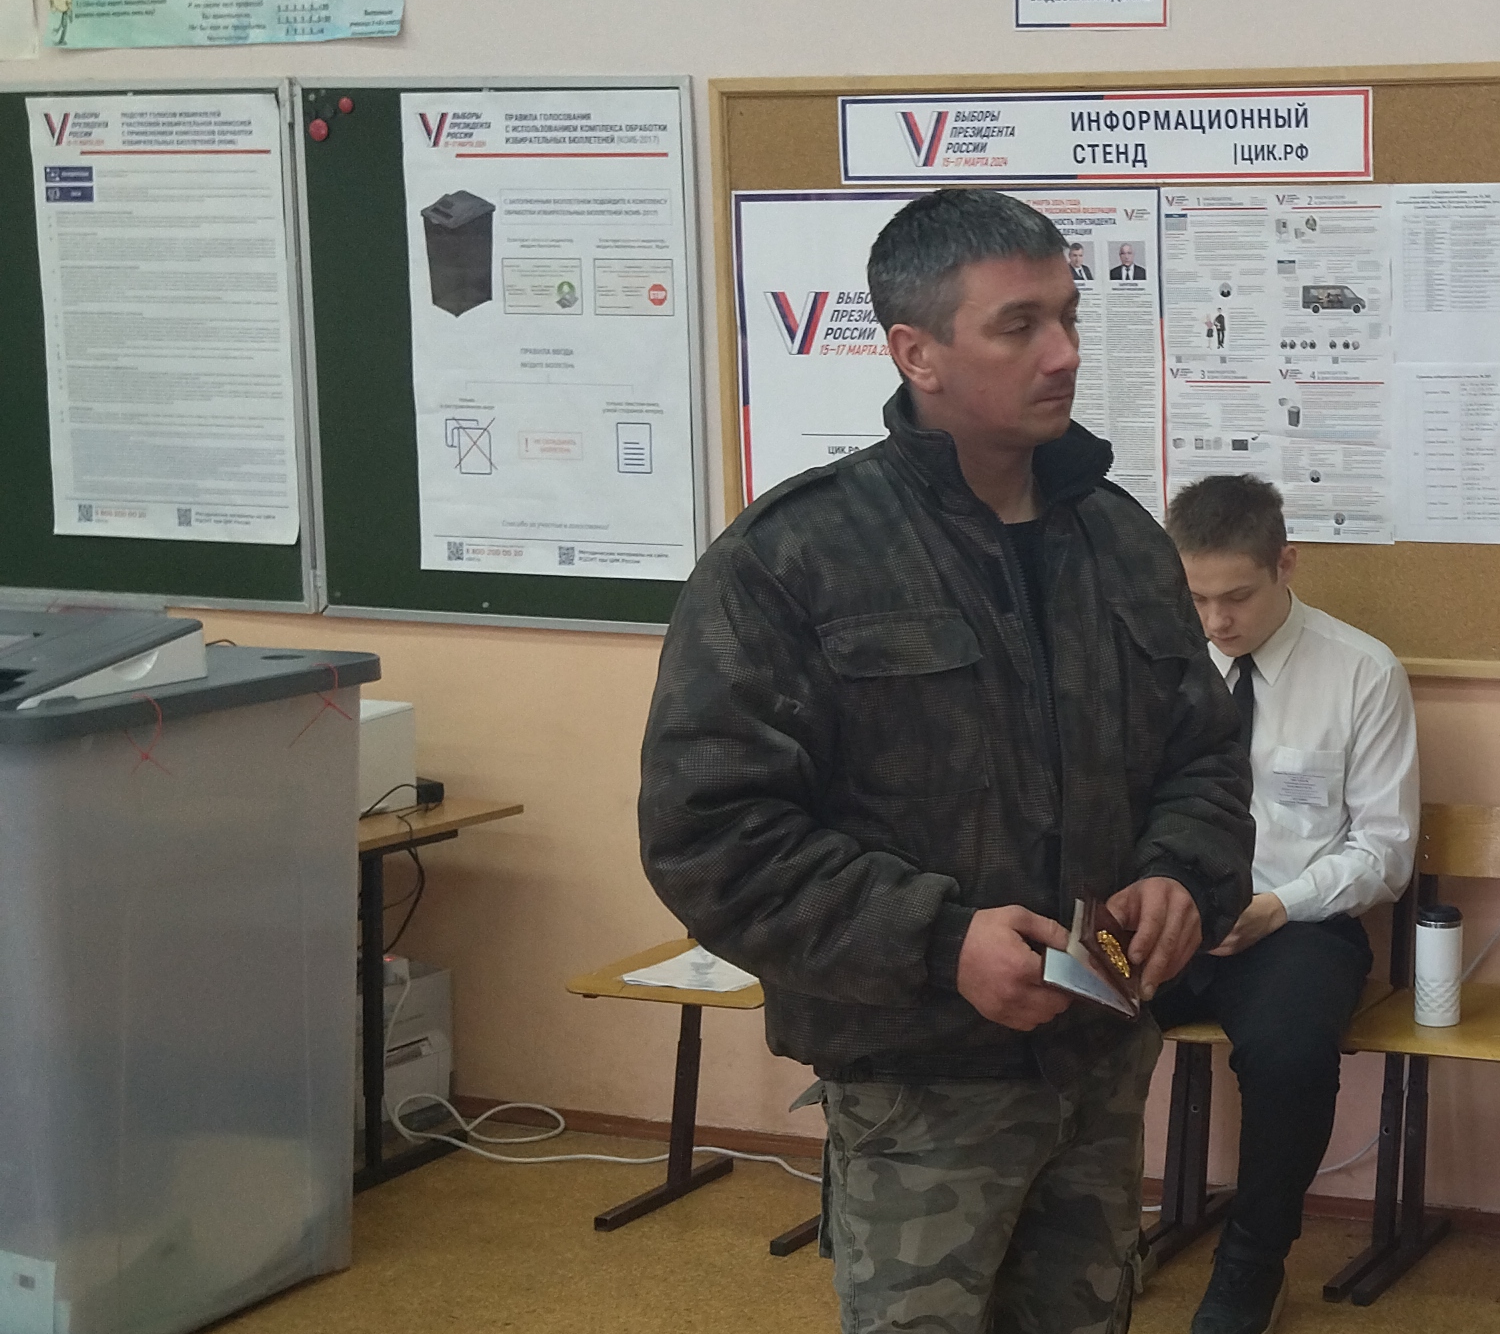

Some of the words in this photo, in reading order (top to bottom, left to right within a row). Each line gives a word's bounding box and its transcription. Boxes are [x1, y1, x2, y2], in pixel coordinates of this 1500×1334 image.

[954, 111, 1001, 122] ВЫБОРЫ
[1071, 102, 1309, 134] ИНФОРМАЦИОННЫЙ
[950, 126, 1015, 139] ПРЕЗИДЕНТА
[946, 142, 988, 153] РОССИИ
[1073, 143, 1147, 167] СТЕНД
[964, 158, 988, 166] МАРТА
[990, 157, 1008, 167] 2024
[836, 292, 873, 305] ВЫБО
[830, 310, 880, 324] ПРЕЗИД
[824, 328, 877, 340] РОССИИ
[848, 345, 878, 355] МАРТА
[879, 345, 892, 357] 20
